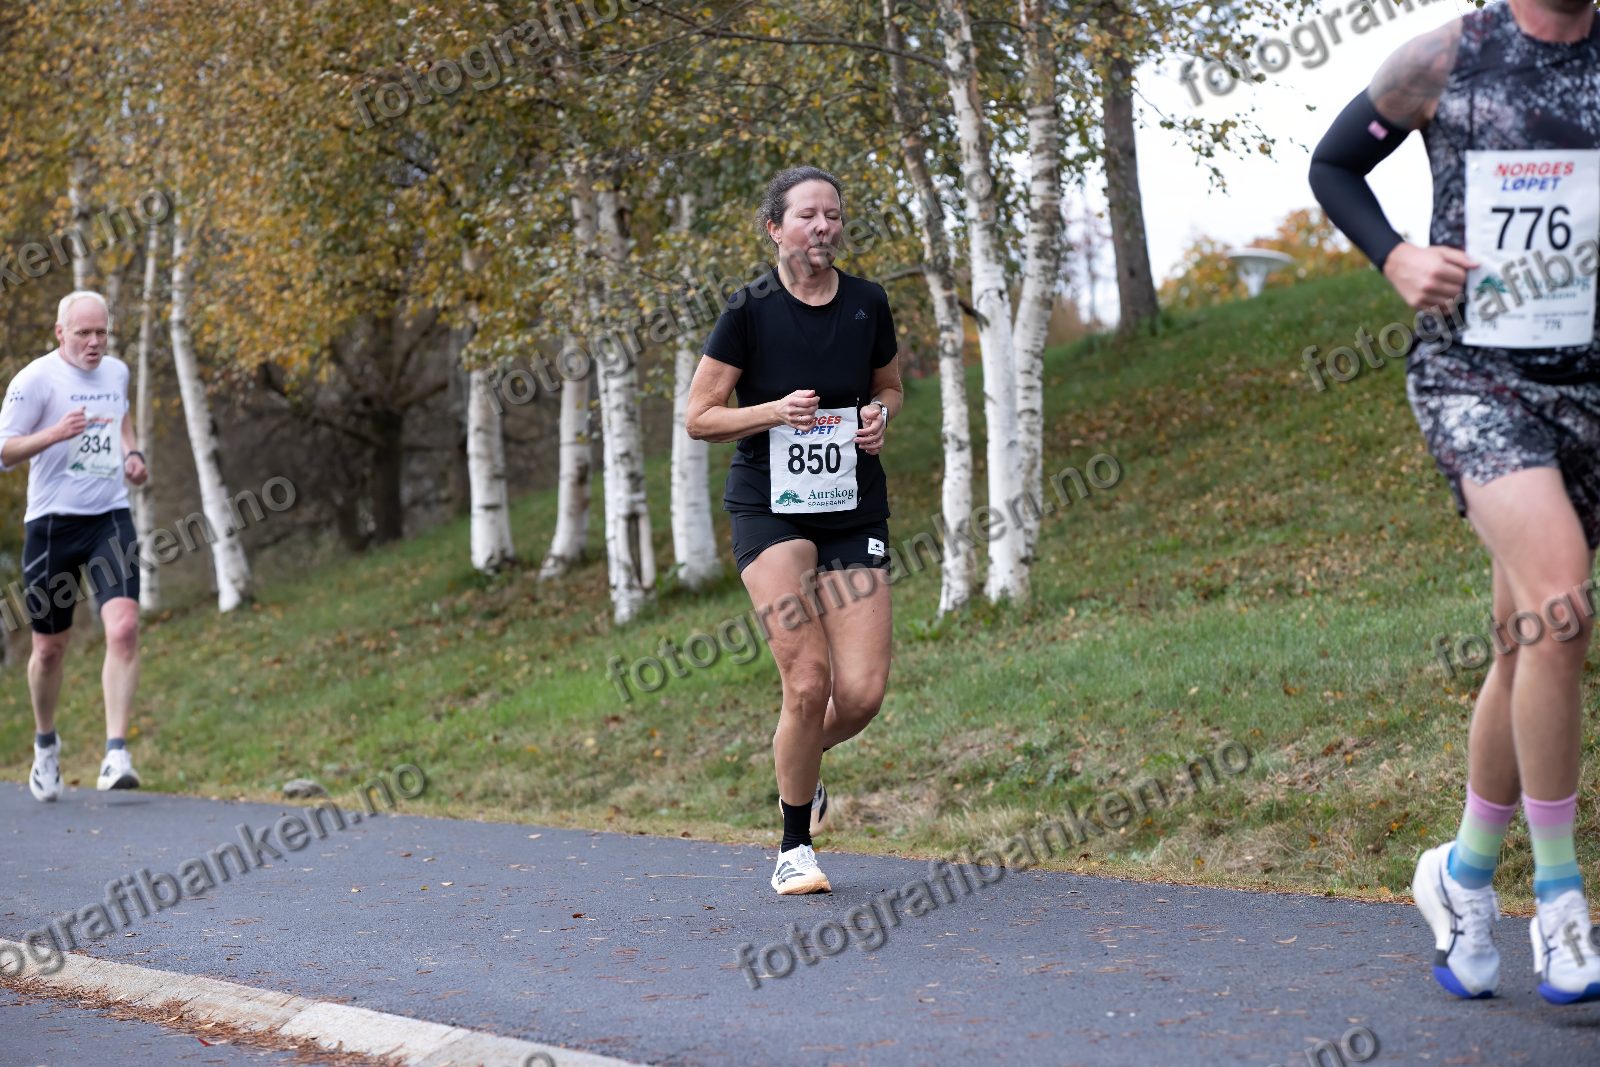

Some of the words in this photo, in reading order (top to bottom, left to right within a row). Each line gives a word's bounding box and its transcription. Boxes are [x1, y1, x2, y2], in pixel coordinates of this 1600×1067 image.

[1495, 162, 1575, 176] NORGES
[1501, 177, 1562, 191] LØPET
[1491, 205, 1571, 250] 776
[80, 435, 111, 454] 334
[787, 442, 841, 475] 850
[808, 487, 854, 500] Aurskog
